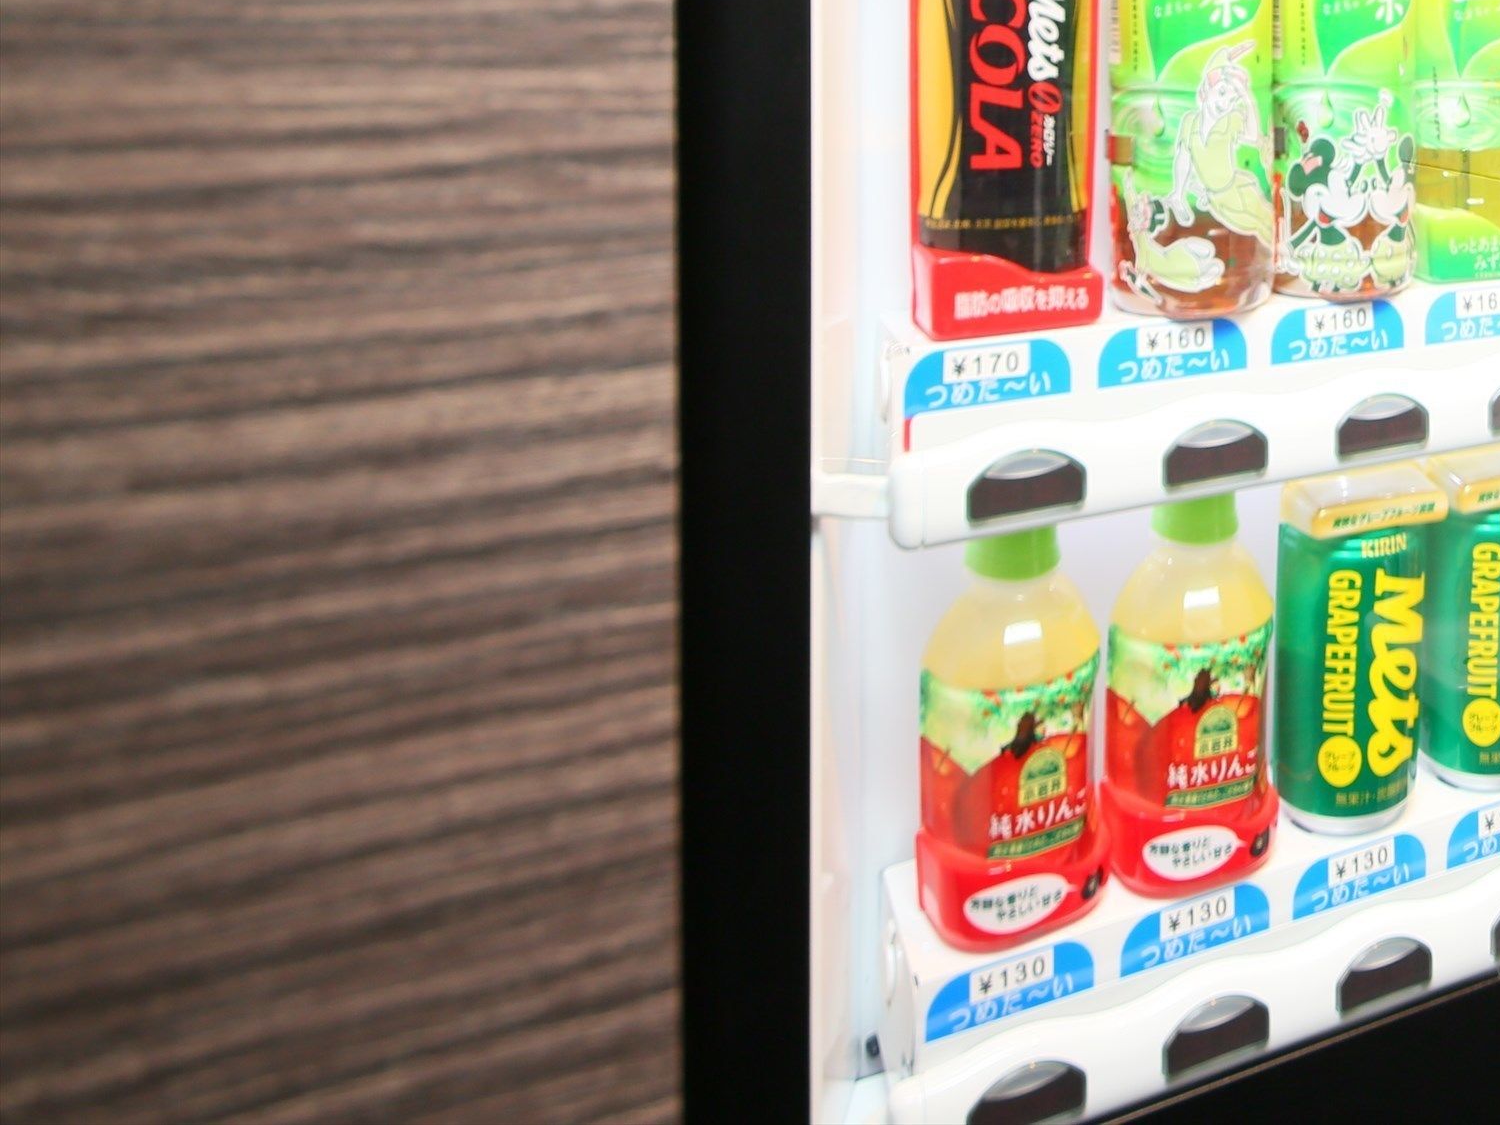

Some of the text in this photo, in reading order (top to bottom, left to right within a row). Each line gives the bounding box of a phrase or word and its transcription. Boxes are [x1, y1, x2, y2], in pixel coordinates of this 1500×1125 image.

[1146, 326, 1207, 351] ¥160
[1312, 309, 1368, 331] ¥160
[952, 352, 1019, 378] ¥170
[1362, 534, 1407, 558] KIRIN
[1322, 569, 1362, 737] GRAPEFRUIT
[1367, 569, 1426, 777] Mets
[1166, 745, 1258, 790] 純水りんご
[988, 787, 1087, 841] 純水りんご
[1334, 844, 1389, 879] ¥130
[1166, 895, 1229, 934] ¥130
[976, 955, 1046, 994] ¥130
